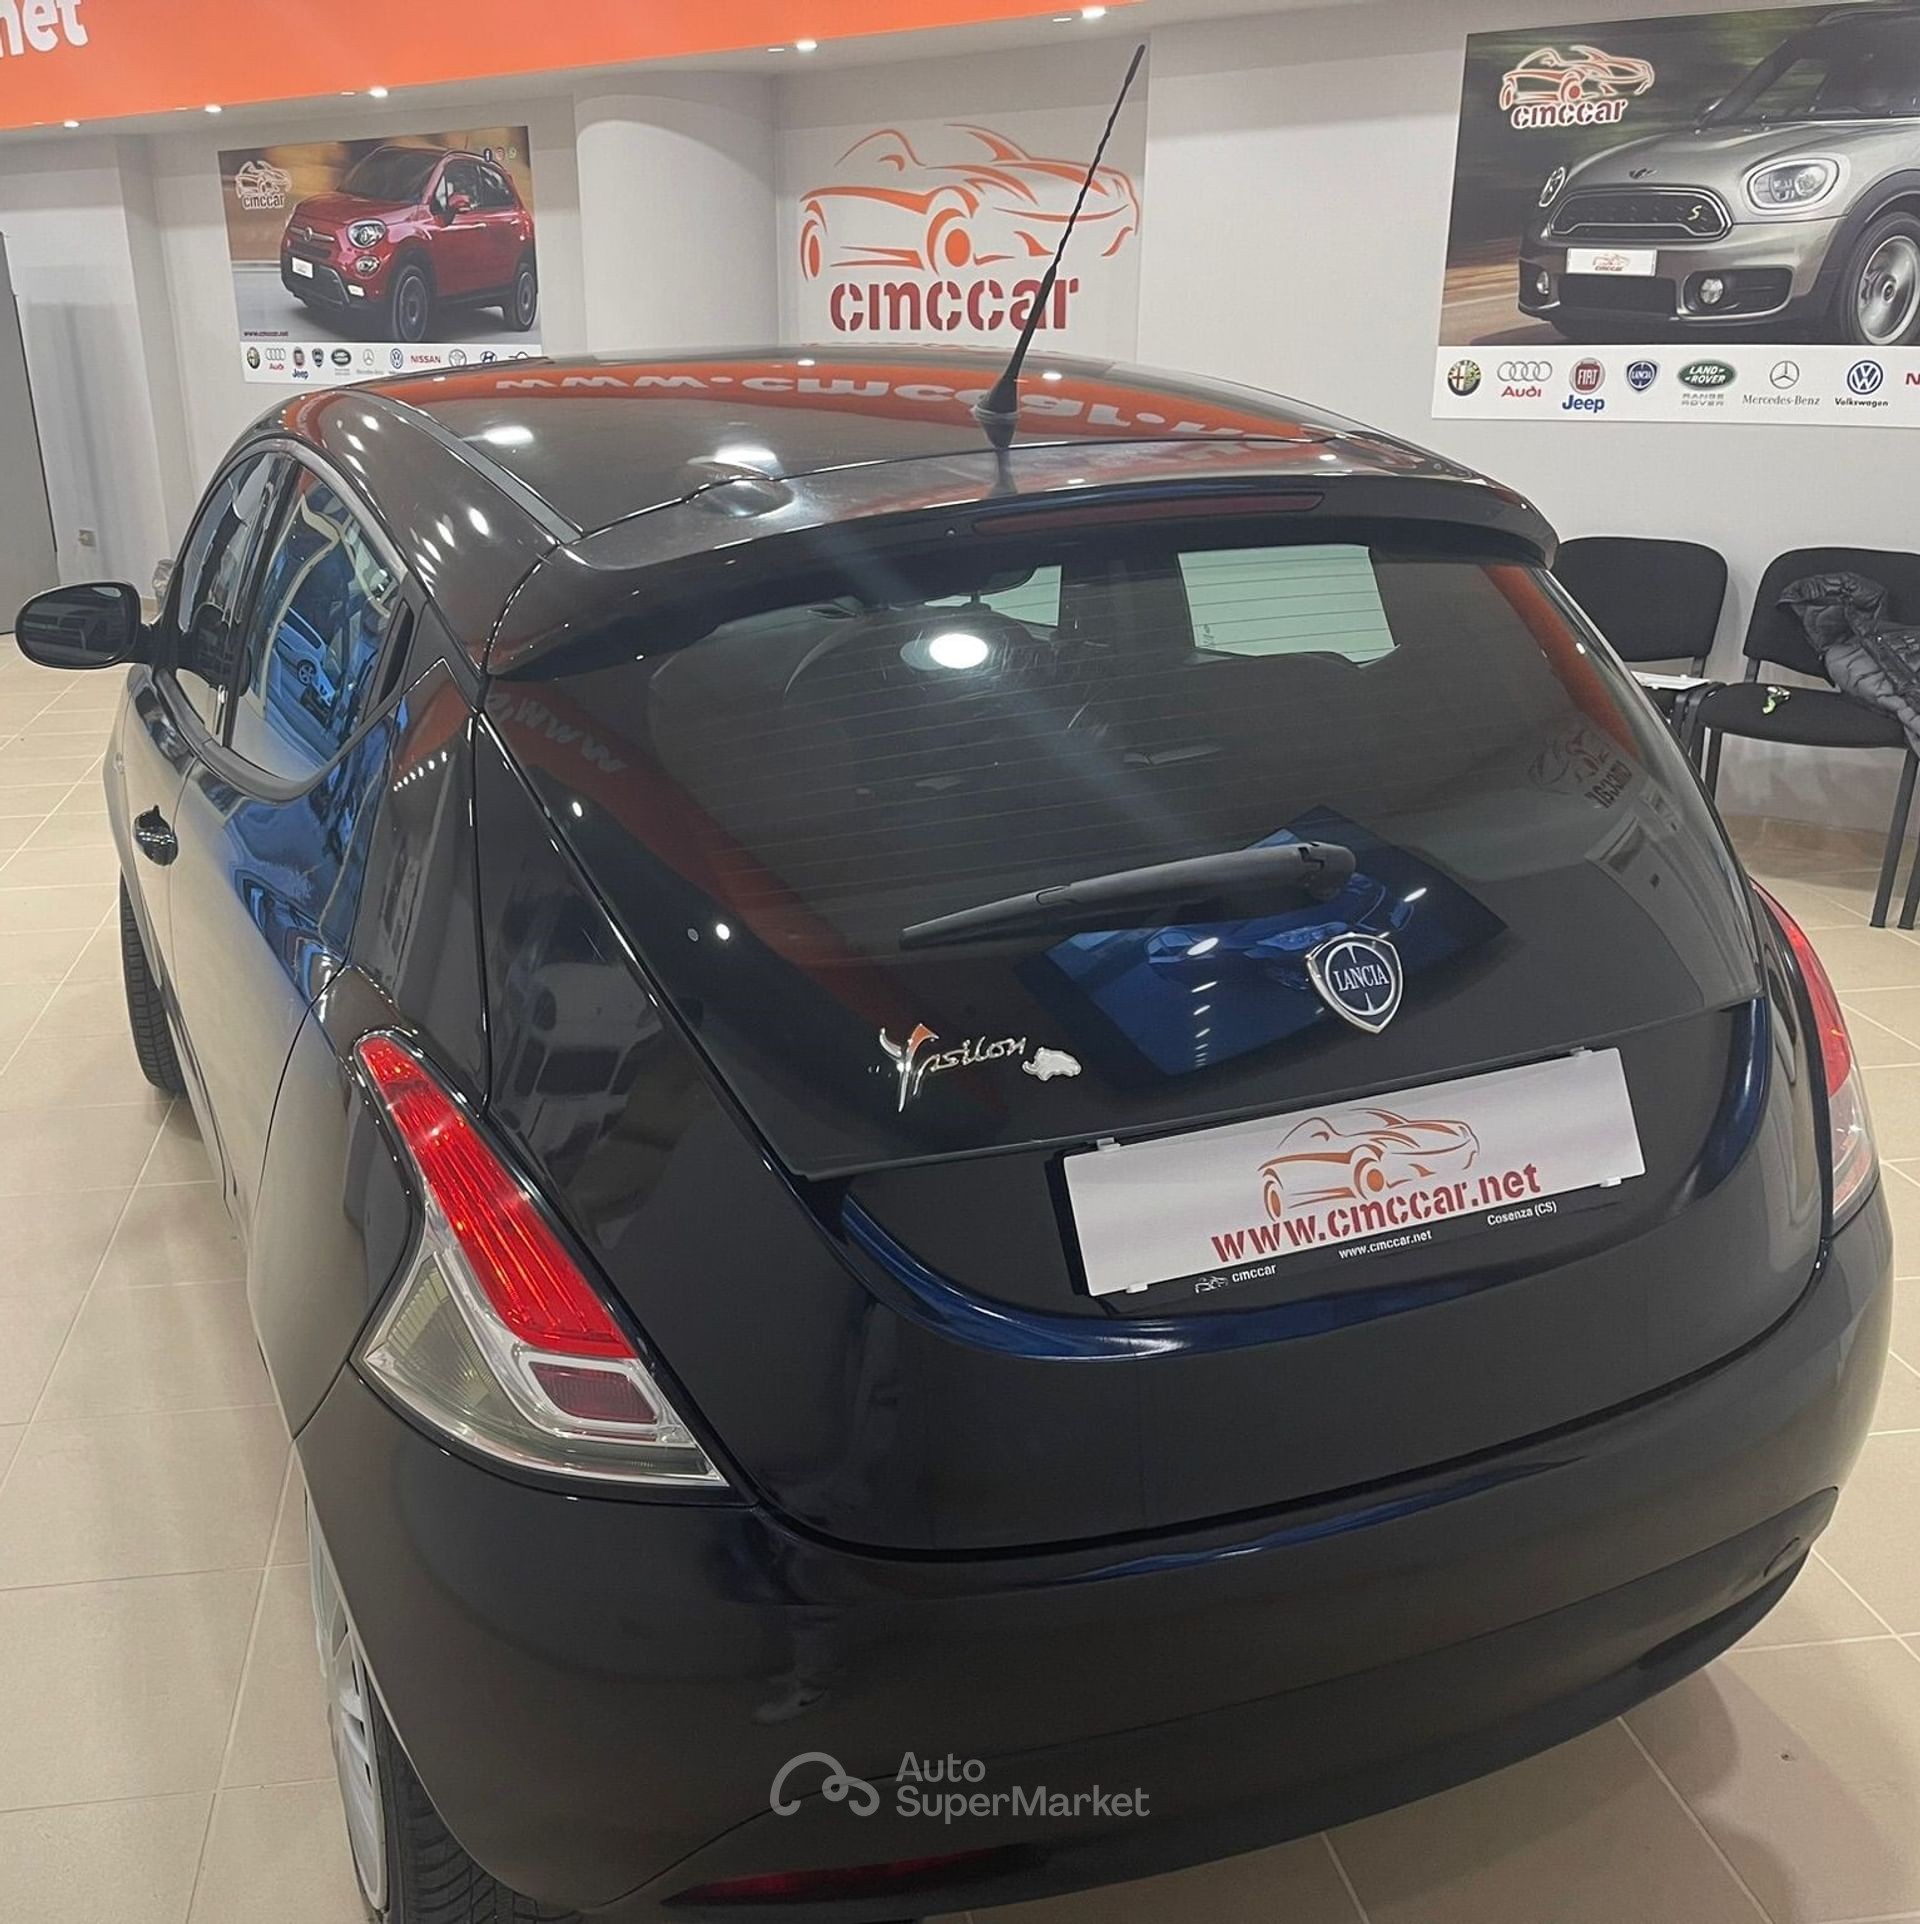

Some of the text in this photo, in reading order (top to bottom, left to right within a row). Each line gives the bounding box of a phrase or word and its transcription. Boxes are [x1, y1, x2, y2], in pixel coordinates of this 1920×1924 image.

[1511, 99, 1628, 129] cmccar
[243, 193, 285, 208] cmccar
[829, 277, 1079, 332] cmccar
[410, 355, 441, 364] NISSAN
[1577, 369, 1599, 385] FIAT
[1501, 386, 1541, 398] Audi
[1742, 395, 1820, 406] Mercedes-Benz
[1562, 394, 1605, 413] Jeep
[1834, 398, 1889, 408] Volkswagen
[1333, 963, 1390, 992] LANCIA
[879, 1022, 1027, 1113] Ypsilon
[1210, 1163, 1541, 1263] www.cmccar.net
[1231, 1200, 1558, 1284] cmccar www.cmccar.net Cosenza (CS)
